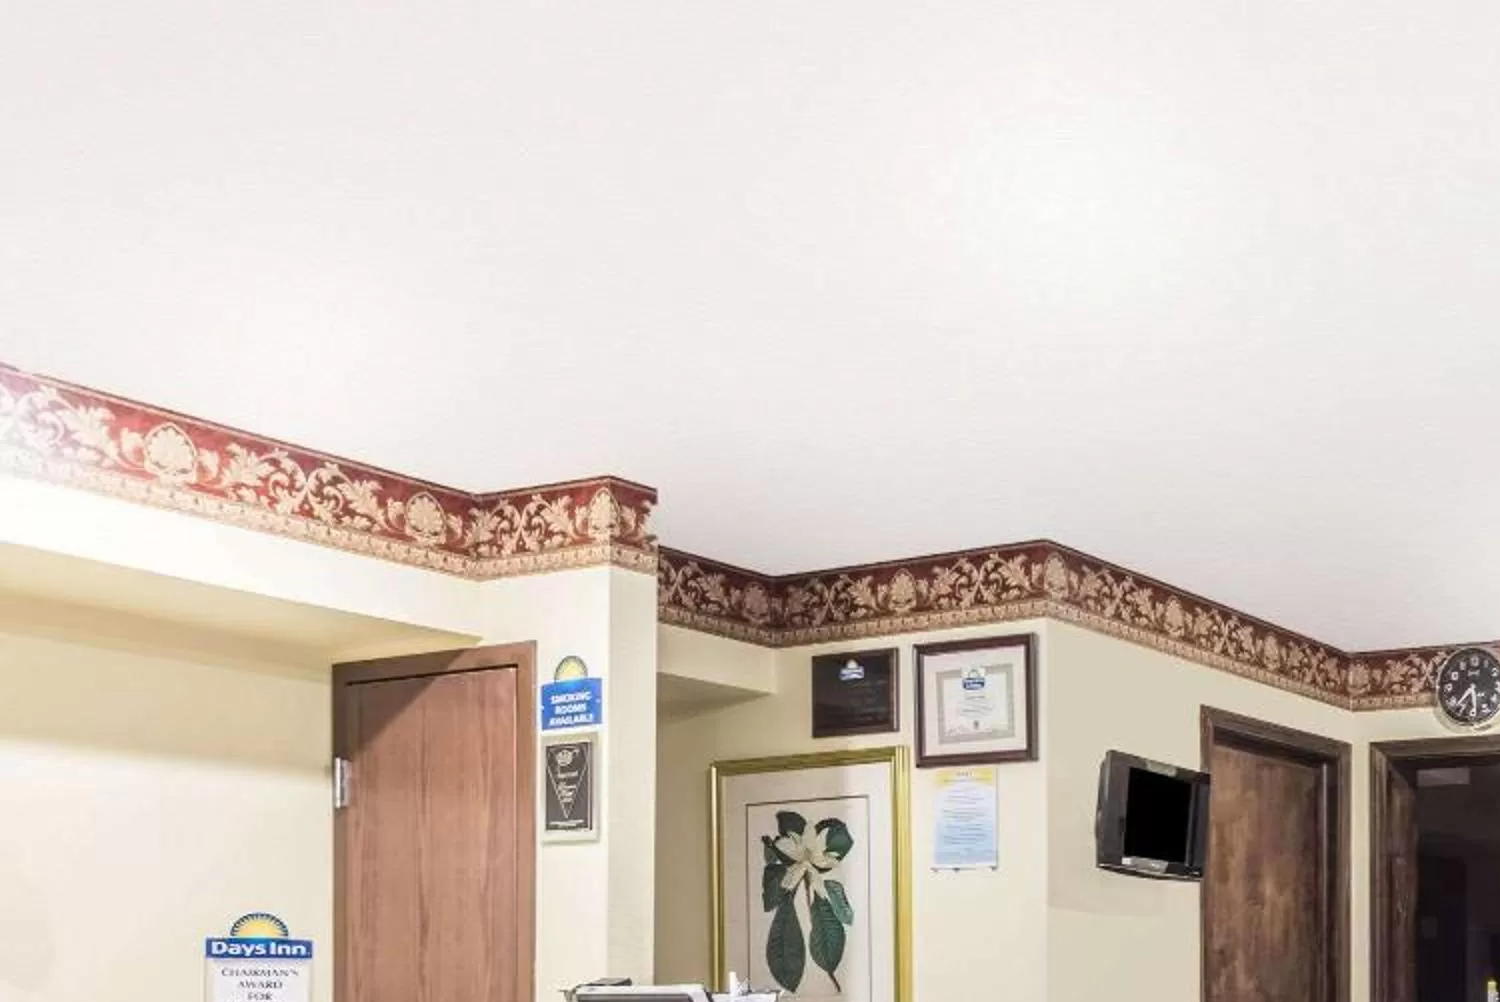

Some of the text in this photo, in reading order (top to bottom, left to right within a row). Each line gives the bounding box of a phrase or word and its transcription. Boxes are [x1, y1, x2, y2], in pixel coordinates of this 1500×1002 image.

[212, 941, 306, 956] Days Inn
[221, 966, 300, 977] CHAIRMAN'S
[238, 981, 282, 989] AWARD
[247, 992, 273, 1001] FOR
